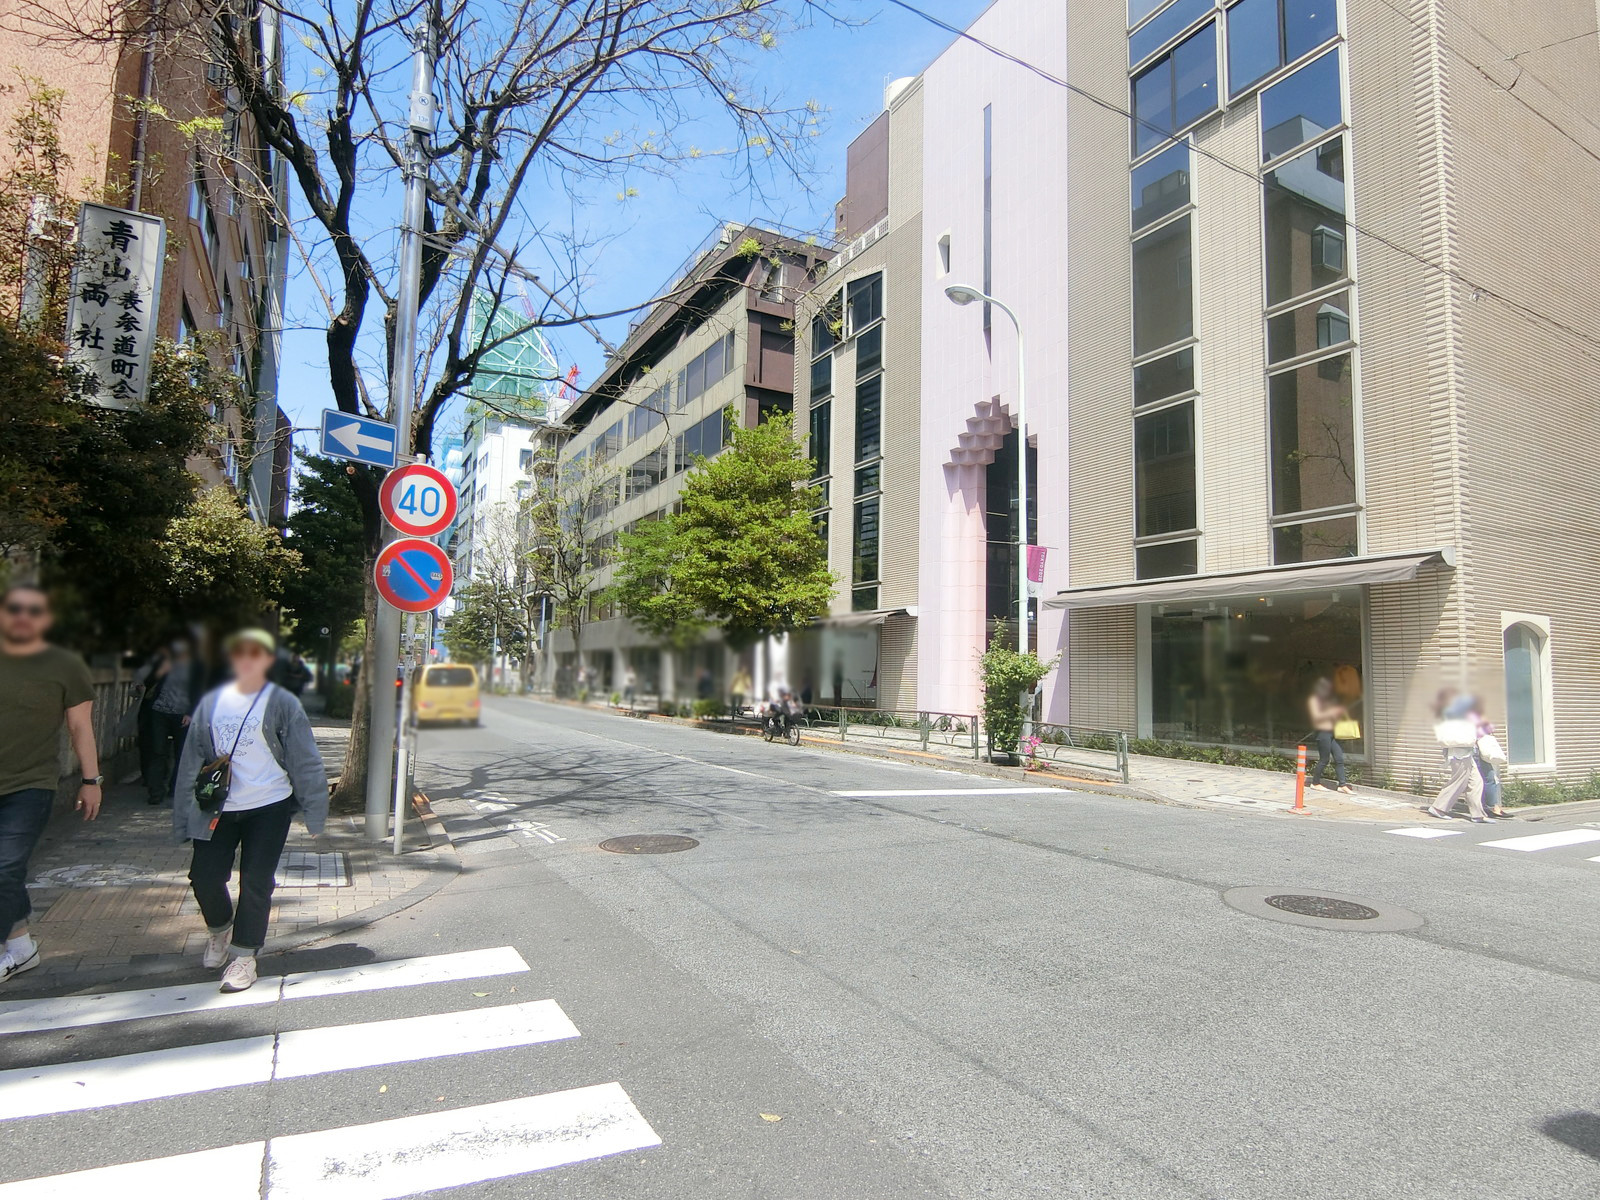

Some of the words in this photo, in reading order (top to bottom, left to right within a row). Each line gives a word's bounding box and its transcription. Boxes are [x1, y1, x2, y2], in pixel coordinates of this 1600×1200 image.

[102, 219, 139, 281] 青山
[108, 290, 144, 399] 表参道町会
[398, 484, 441, 517] 40
